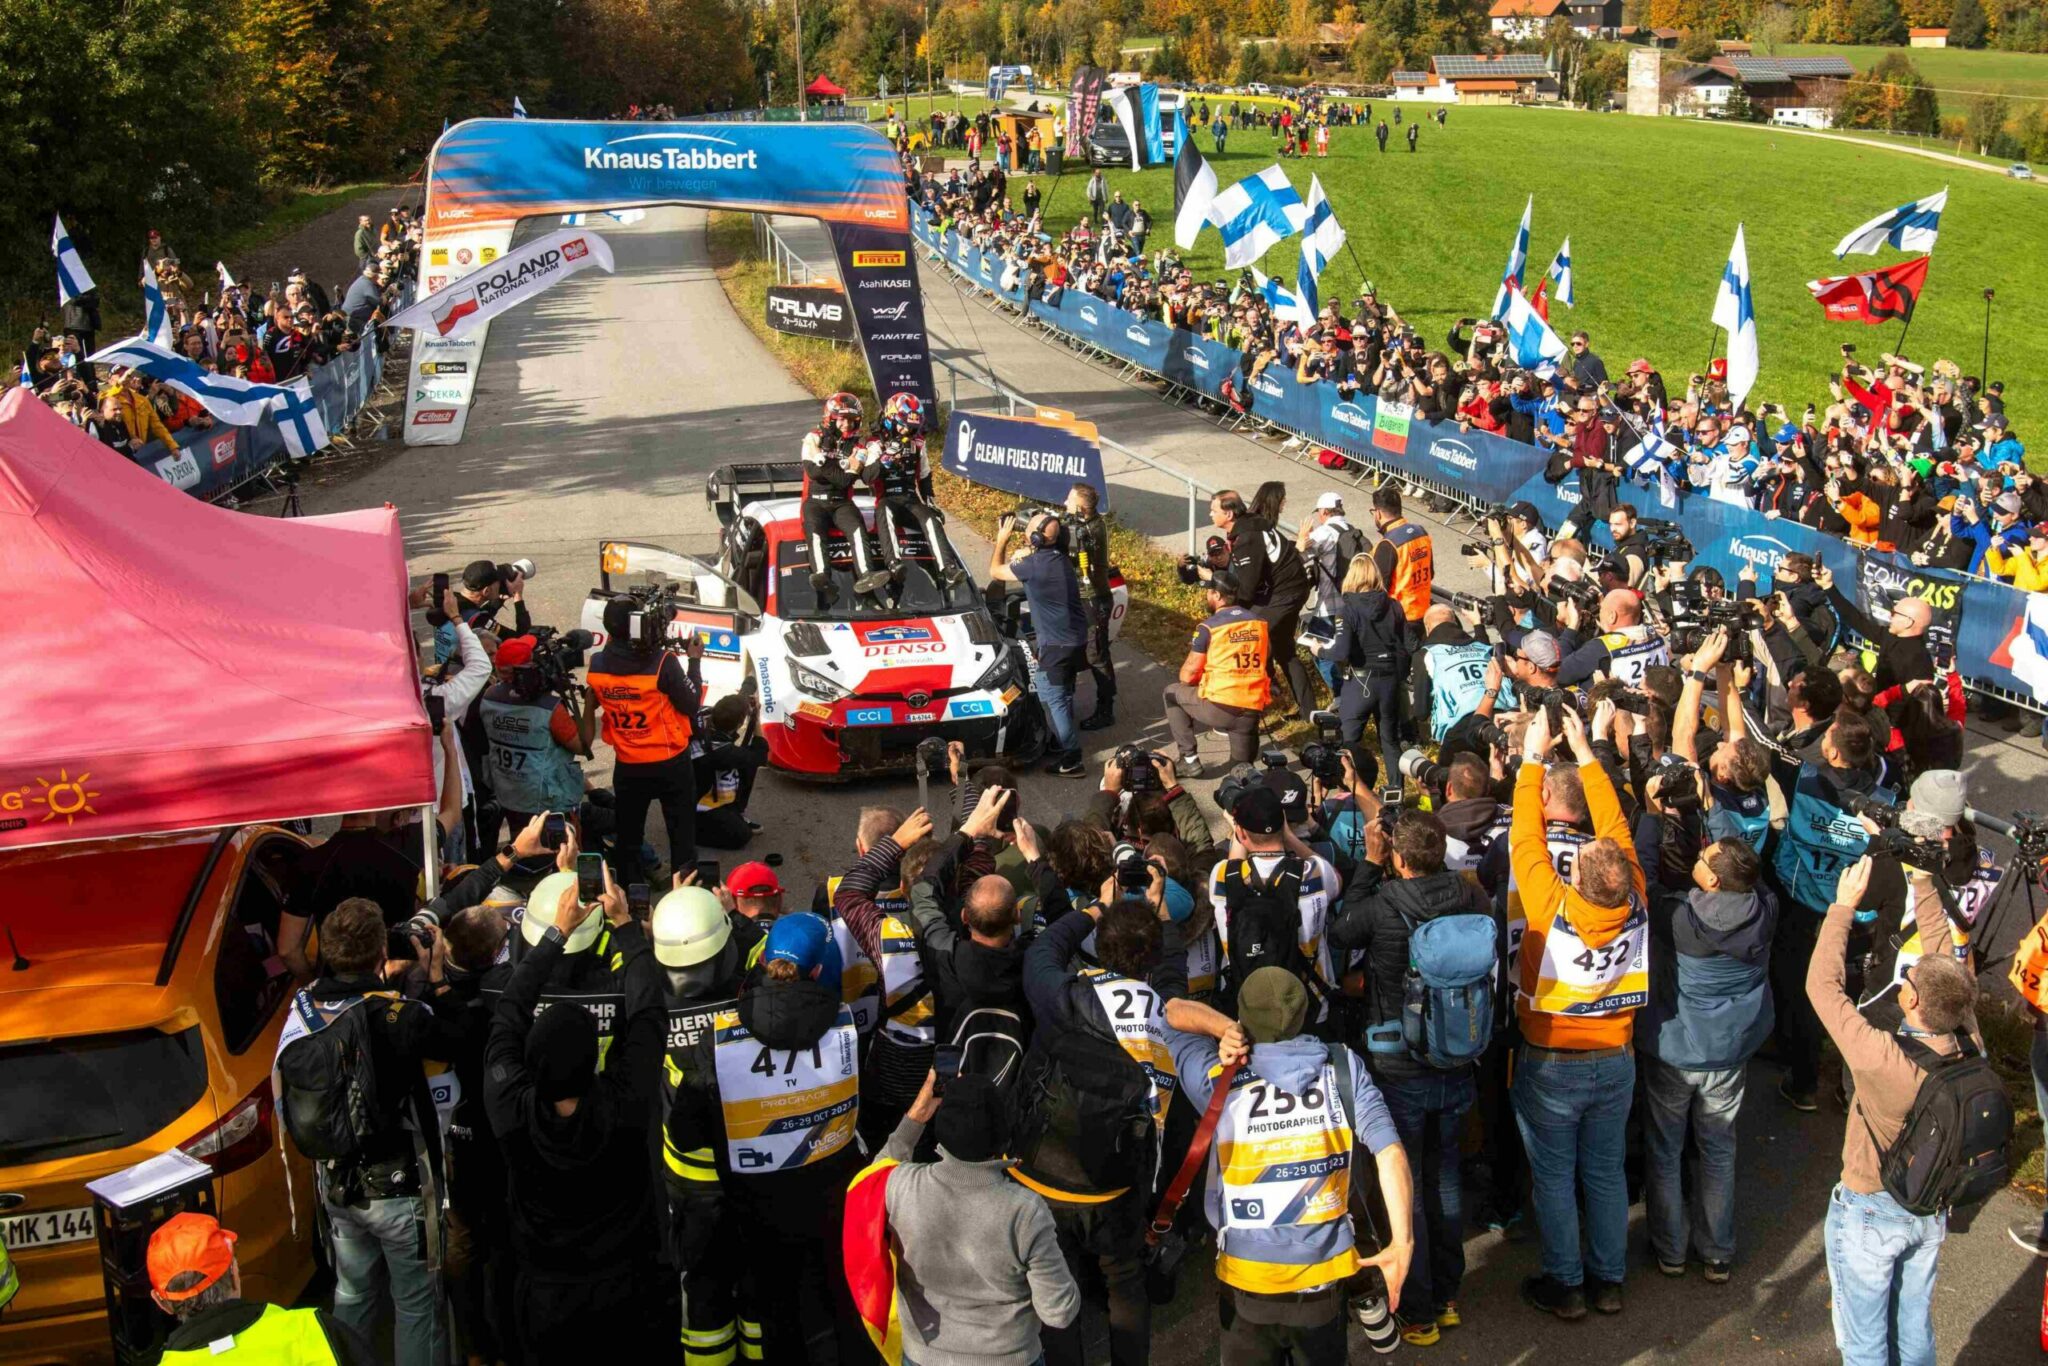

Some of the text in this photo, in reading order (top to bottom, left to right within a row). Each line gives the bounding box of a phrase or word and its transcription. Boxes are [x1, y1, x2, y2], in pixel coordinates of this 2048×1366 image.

[431, 248, 448, 256] ADAC
[857, 253, 901, 264] PIRELLI
[476, 249, 561, 298] POLAND
[480, 262, 560, 306] NATIONAL TEAM
[769, 295, 843, 322] FORUM8
[871, 333, 923, 341] FANATEC
[429, 389, 462, 399] DEKRA
[974, 442, 1087, 477] CLEAN FUELS FOR ALL
[172, 459, 196, 481] DEKRA
[1228, 628, 1260, 639] WRC
[864, 642, 947, 657] DENSO
[896, 656, 934, 665] Microsoft
[1233, 652, 1261, 669] 135
[1457, 663, 1488, 681] 16
[757, 656, 777, 714] Panasonic
[611, 711, 649, 730] 122
[496, 749, 527, 771] 197
[1810, 813, 1865, 835] WRC
[1820, 835, 1850, 847] MEDIA
[1573, 939, 1630, 972] 432
[1093, 972, 1112, 982] WRC
[2014, 960, 2041, 991] 142
[1605, 998, 1620, 1007] OCT
[1621, 995, 1641, 1005] 2023
[785, 1078, 797, 1088] TV
[1249, 1082, 1325, 1118] 256
[781, 1117, 812, 1131] 26-29
[813, 1110, 830, 1123] OCT
[1247, 1114, 1326, 1135] PHOTOGRAPHER
[1275, 1166, 1308, 1178] 26-29
[1309, 1163, 1328, 1174] OCT
[9, 1210, 94, 1246] MK 144
